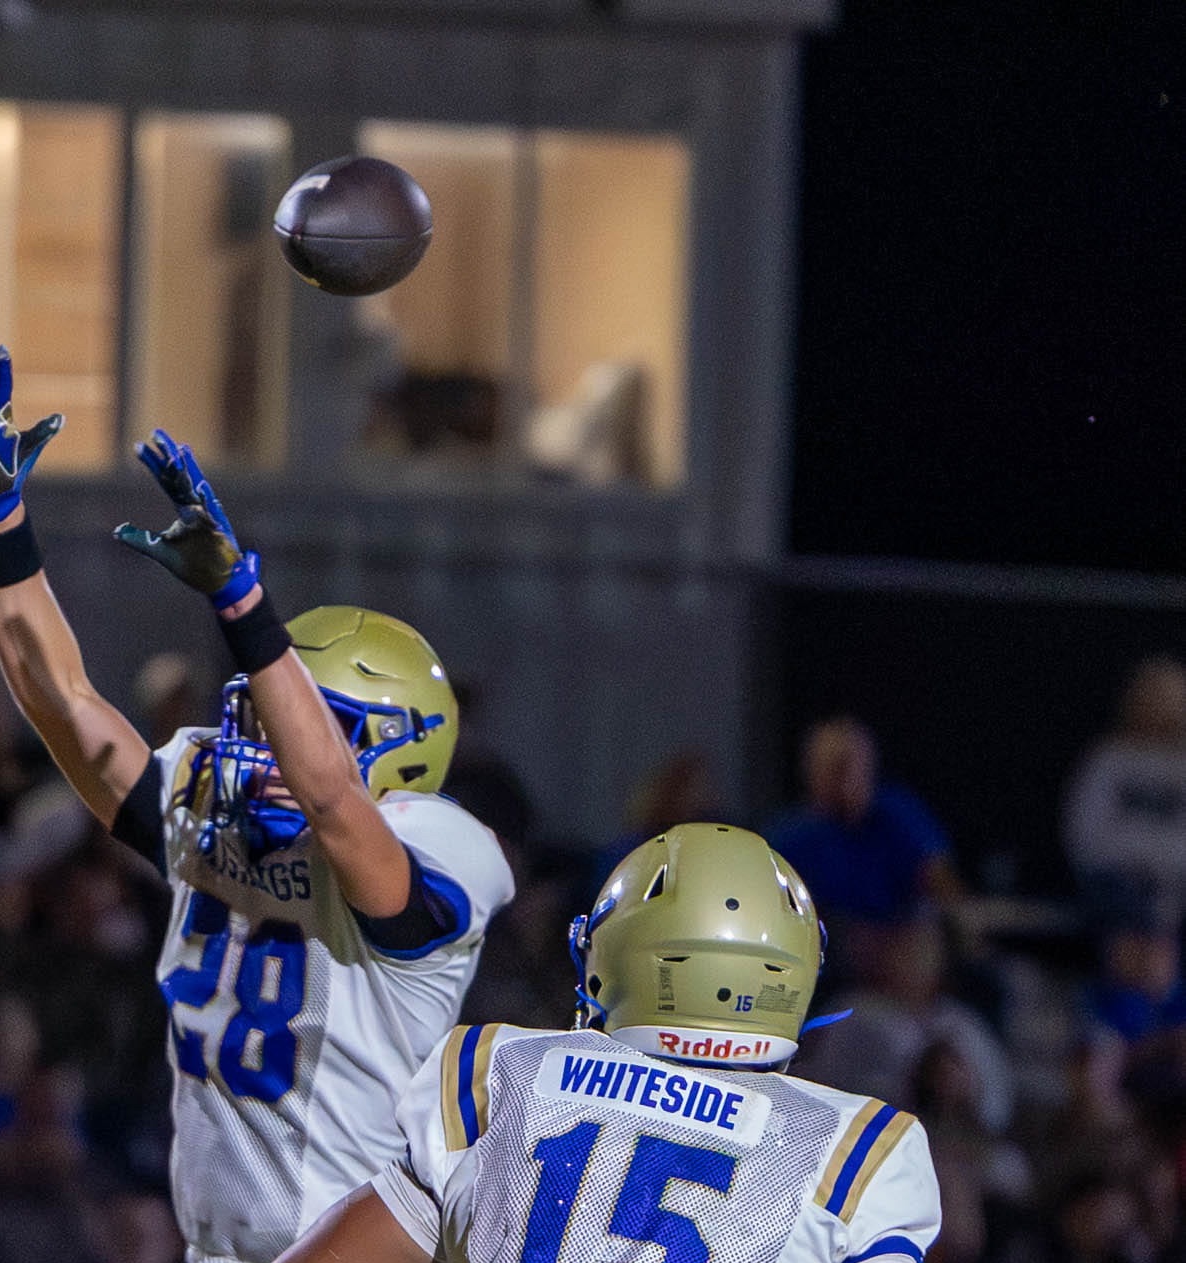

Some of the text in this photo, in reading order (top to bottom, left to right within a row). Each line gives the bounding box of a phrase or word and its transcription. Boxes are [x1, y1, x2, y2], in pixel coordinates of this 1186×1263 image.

[158, 890, 308, 1104] 28
[734, 995, 755, 1013] 15
[658, 1032, 771, 1060] Riddell
[560, 1055, 744, 1130] WHITESIDE
